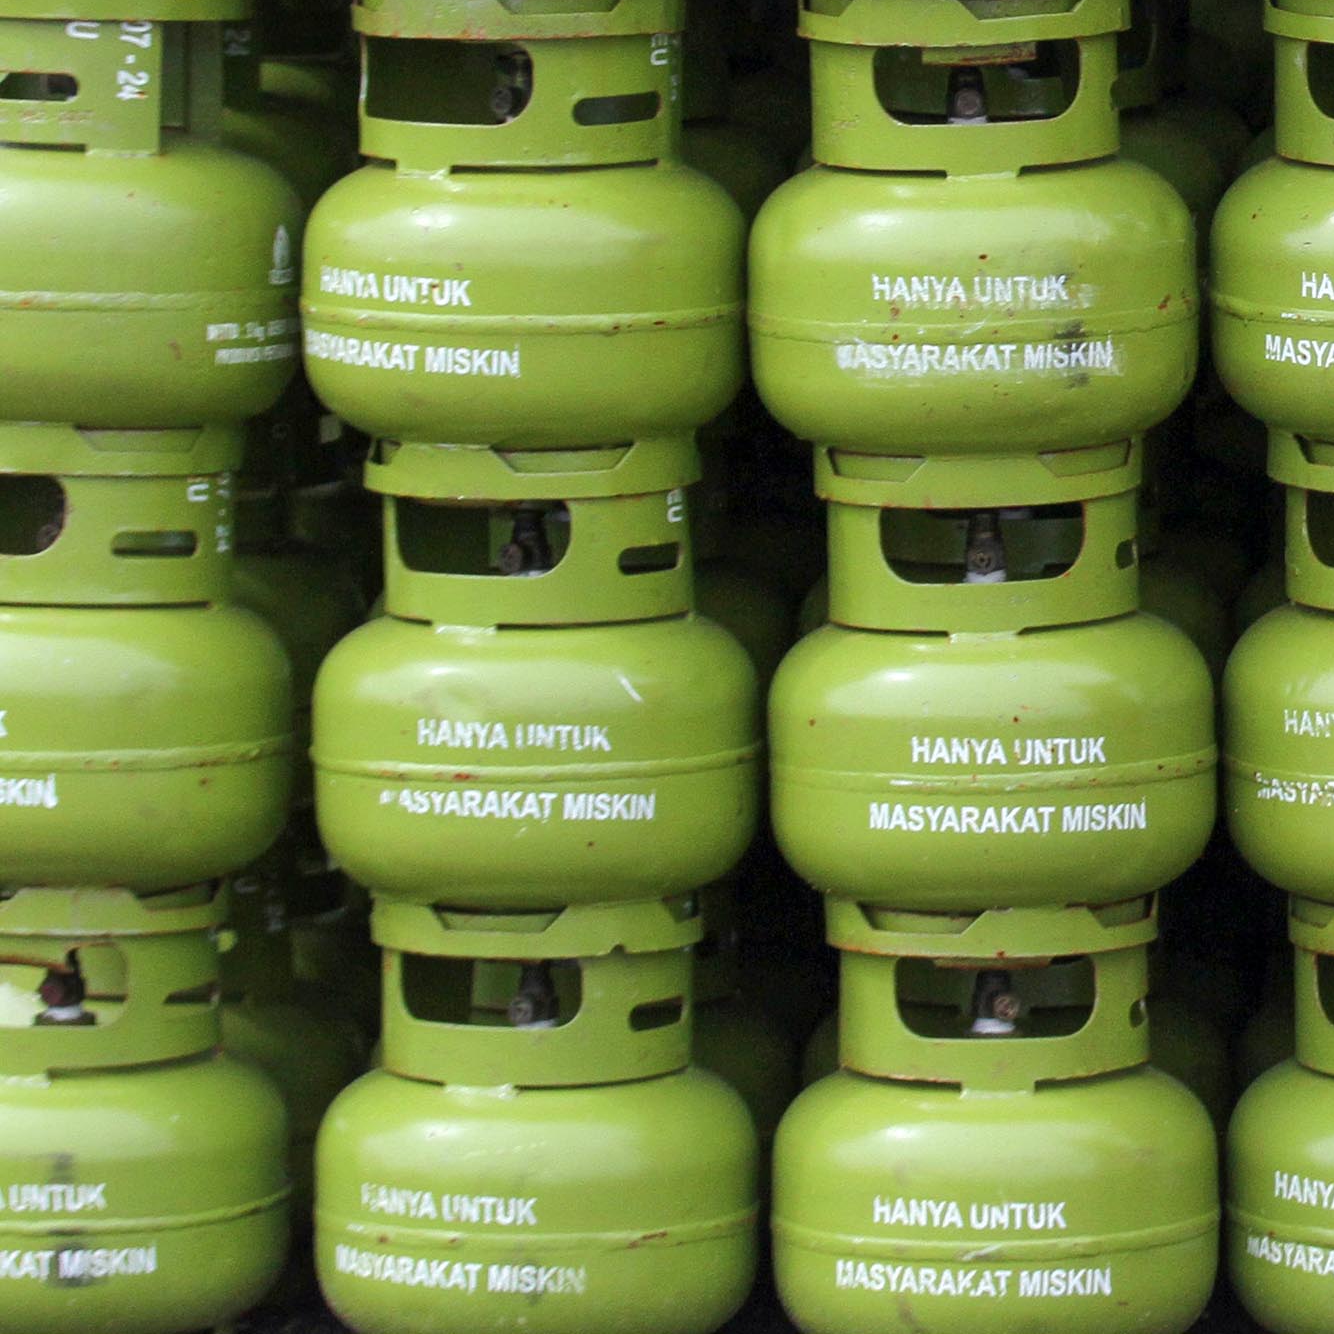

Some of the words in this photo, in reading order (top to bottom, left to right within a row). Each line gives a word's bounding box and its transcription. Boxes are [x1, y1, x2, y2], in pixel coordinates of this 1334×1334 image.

[320, 267, 380, 299] HANYA
[383, 274, 472, 307] UNTUK
[871, 274, 967, 307] HANYA
[973, 275, 1069, 306] UNTUK
[424, 346, 521, 378] MISKIN
[837, 342, 1017, 372] MASYARAKAT
[1023, 339, 1116, 371] MISKIN
[417, 718, 509, 749] HANYA
[515, 723, 612, 752] UNTUK
[910, 736, 1008, 765] HANYA
[1014, 736, 1106, 765] UNTUK
[380, 789, 559, 823] ASYARAKAT
[562, 792, 656, 821] MISKIN
[869, 802, 1056, 834] MASYARAKAT
[1061, 802, 1147, 833] MISKIN
[8, 1183, 106, 1213] UNTUK
[441, 1194, 537, 1226] UNTUK
[873, 1196, 964, 1229] HANYA
[969, 1201, 1067, 1230] UNTUK
[58, 1246, 157, 1278] MISKIN
[335, 1244, 483, 1293] MASYARAKAT
[487, 1264, 585, 1294] MISKIN
[835, 1259, 1013, 1297] MASYARAKAT
[1018, 1268, 1112, 1297] MISKIN
